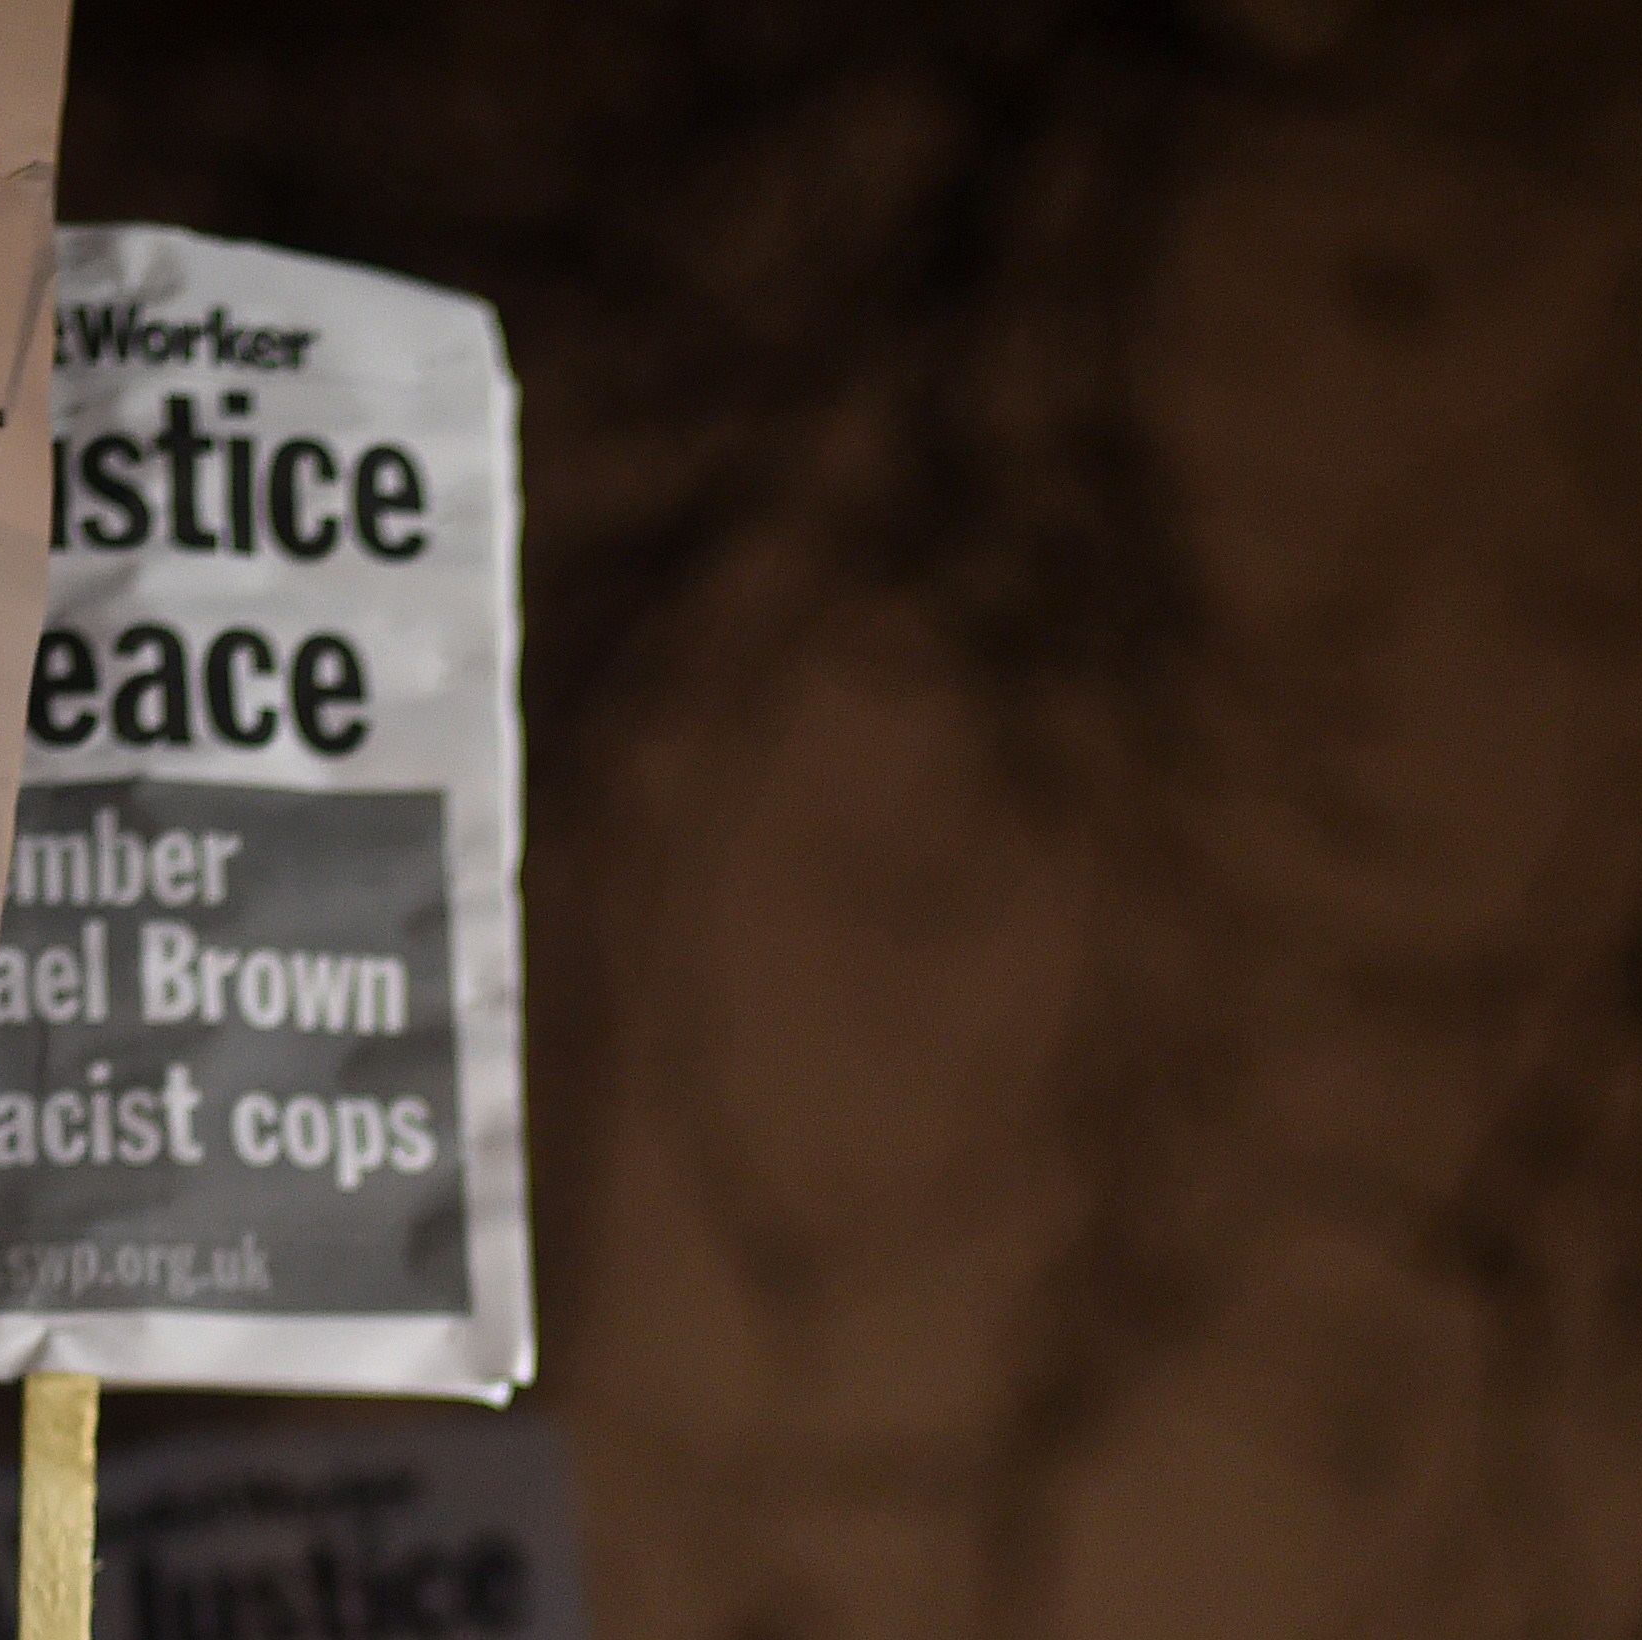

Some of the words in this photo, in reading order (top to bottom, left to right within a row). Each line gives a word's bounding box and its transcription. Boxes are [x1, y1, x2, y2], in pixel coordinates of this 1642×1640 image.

[71, 302, 319, 371] Worker
[51, 392, 429, 564] stice
[25, 616, 371, 759] eace
[140, 920, 410, 1037] Brown
[231, 1092, 440, 1194] cops
